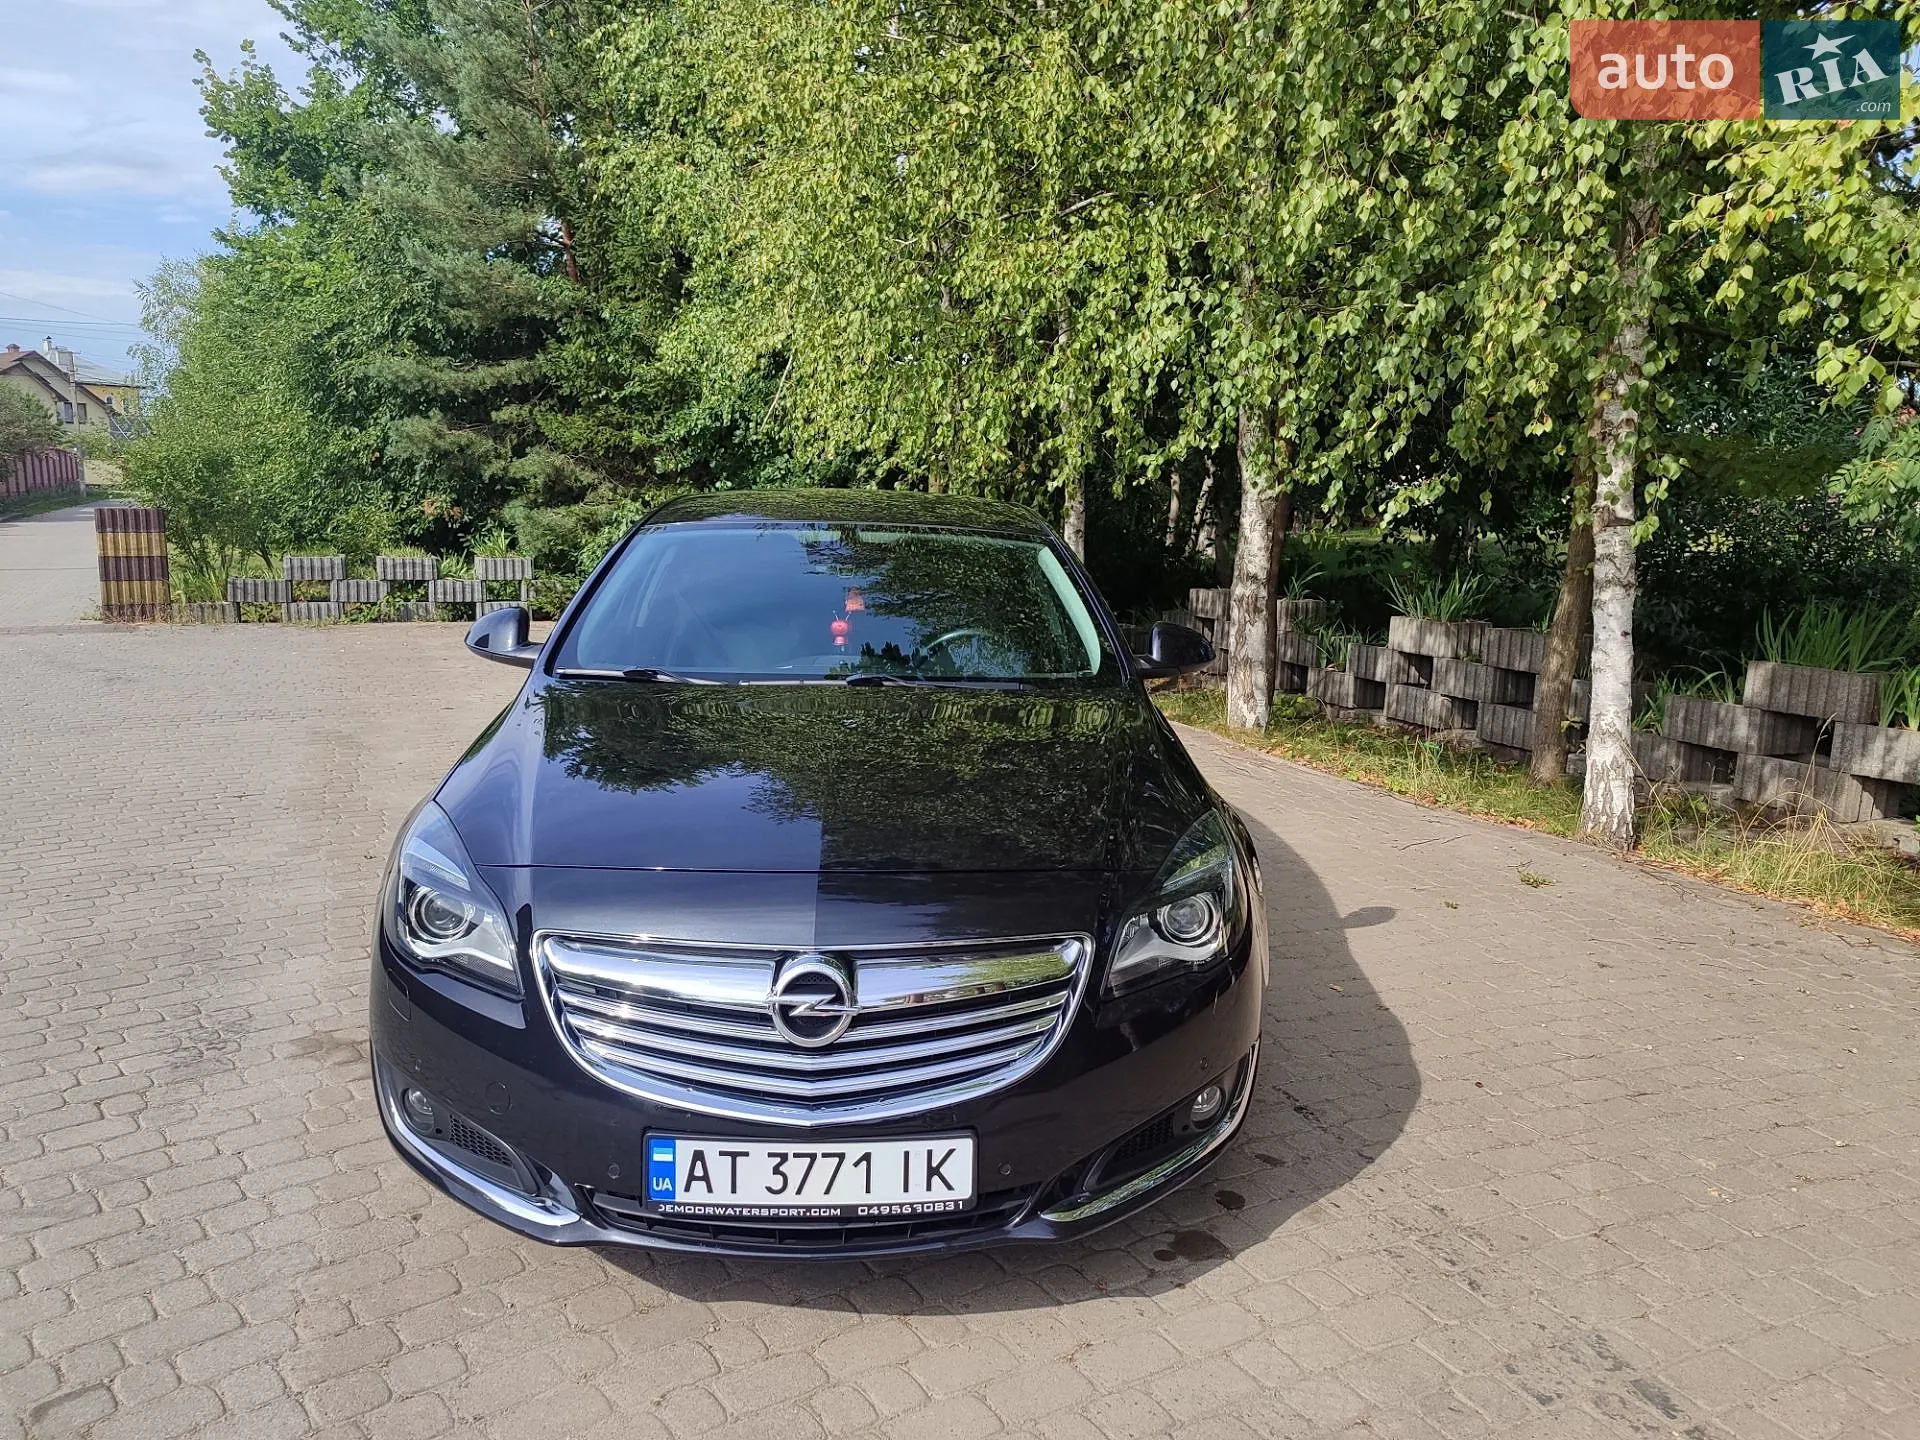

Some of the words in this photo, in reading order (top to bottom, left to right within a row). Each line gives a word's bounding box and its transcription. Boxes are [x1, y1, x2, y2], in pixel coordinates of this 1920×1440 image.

[653, 1177, 673, 1191] UA
[684, 1149, 750, 1194] AT
[764, 1151, 872, 1196] 3771
[903, 1148, 957, 1193] IK
